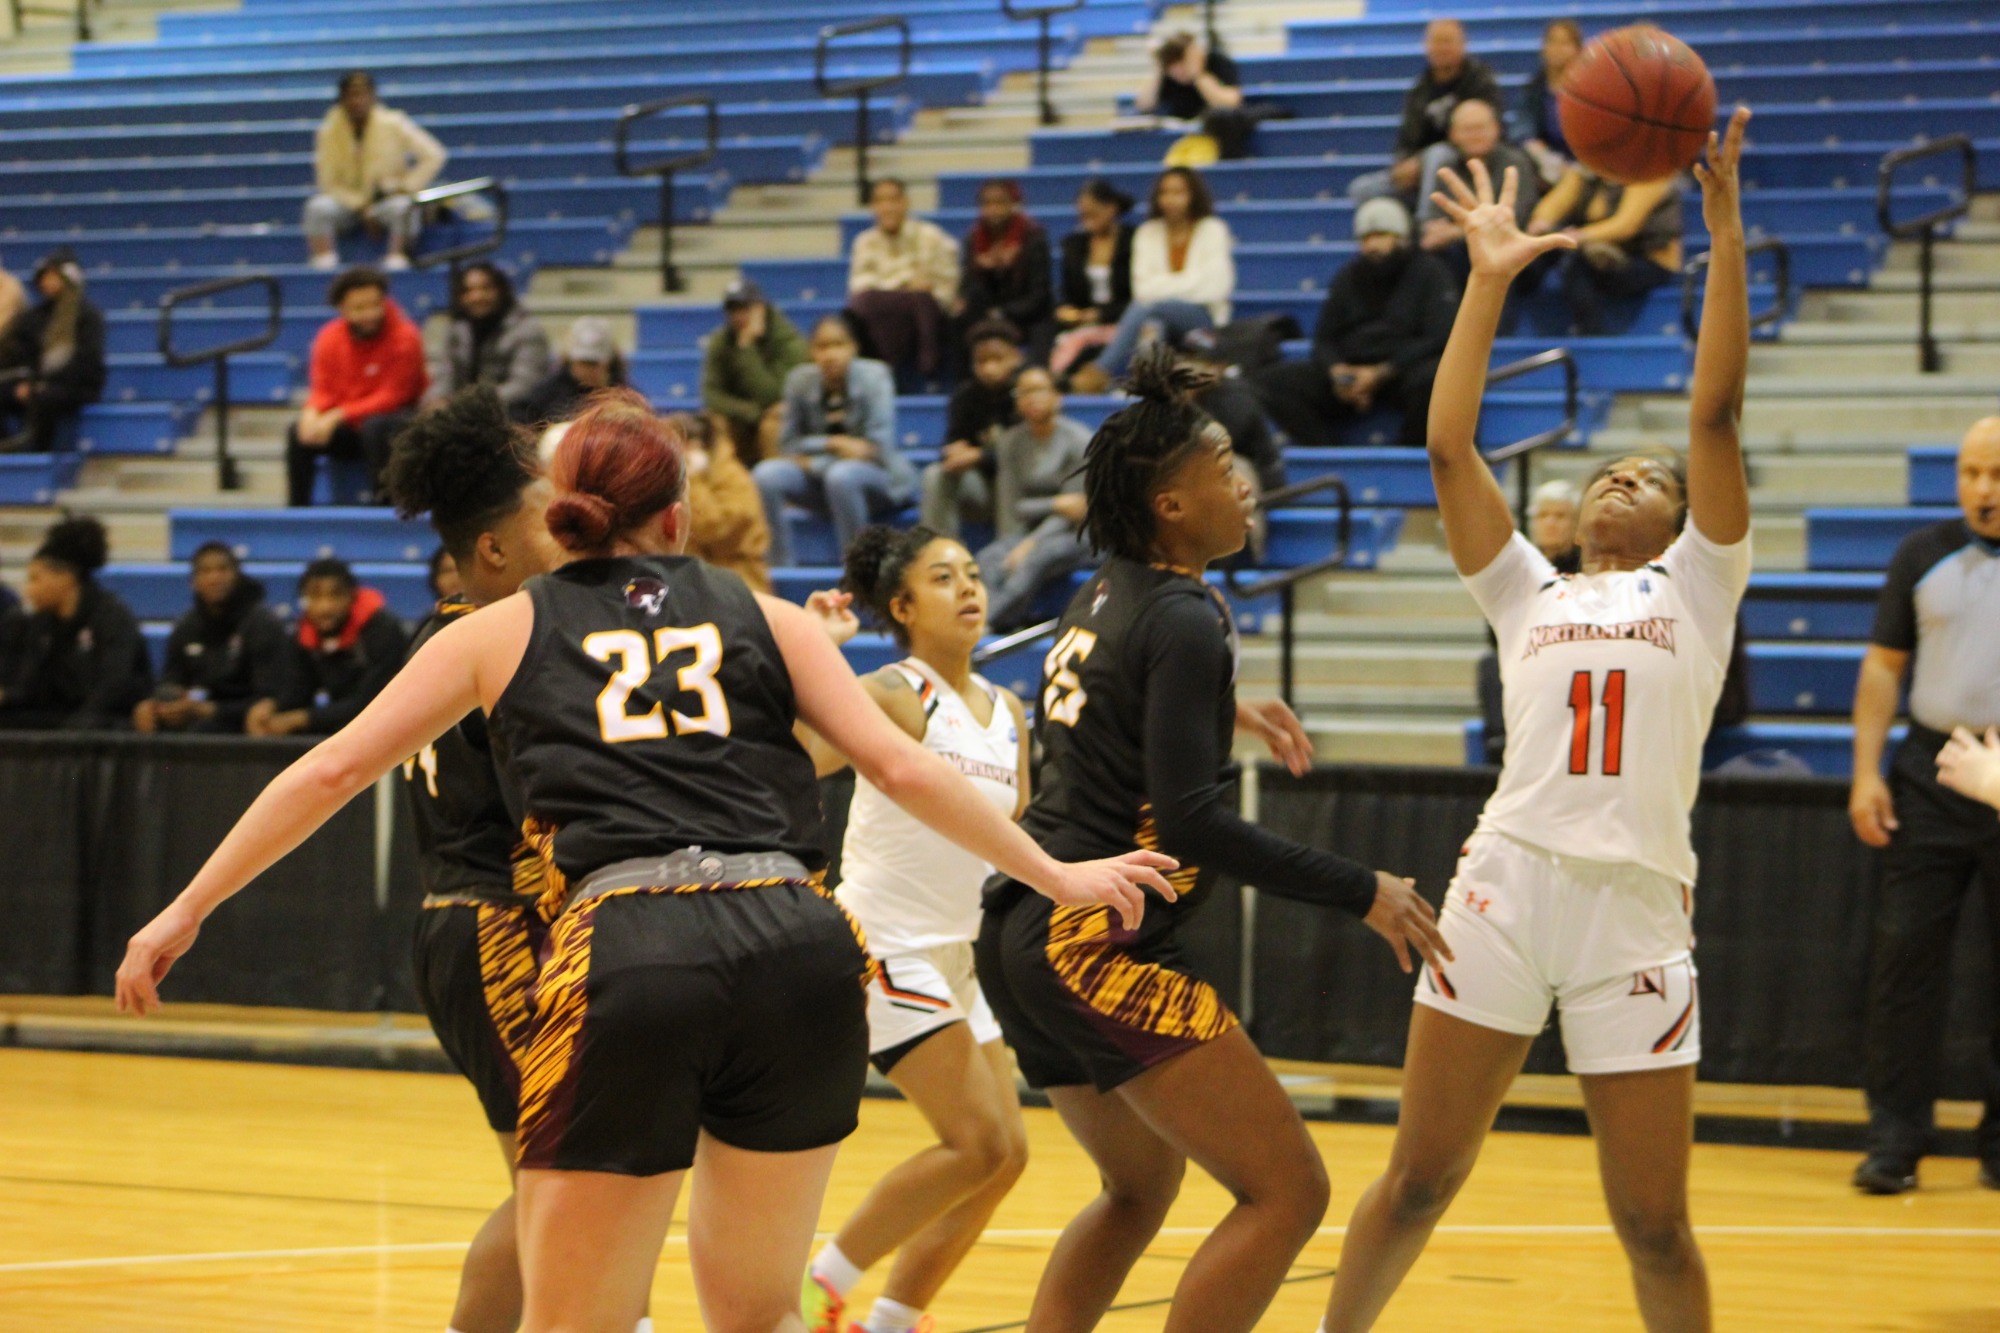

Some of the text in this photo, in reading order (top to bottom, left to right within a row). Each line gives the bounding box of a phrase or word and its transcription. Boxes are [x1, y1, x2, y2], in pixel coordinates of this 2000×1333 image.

[582, 622, 731, 743] 23
[1521, 617, 1678, 661] NORTHAMPTON
[1567, 669, 1626, 776] 11
